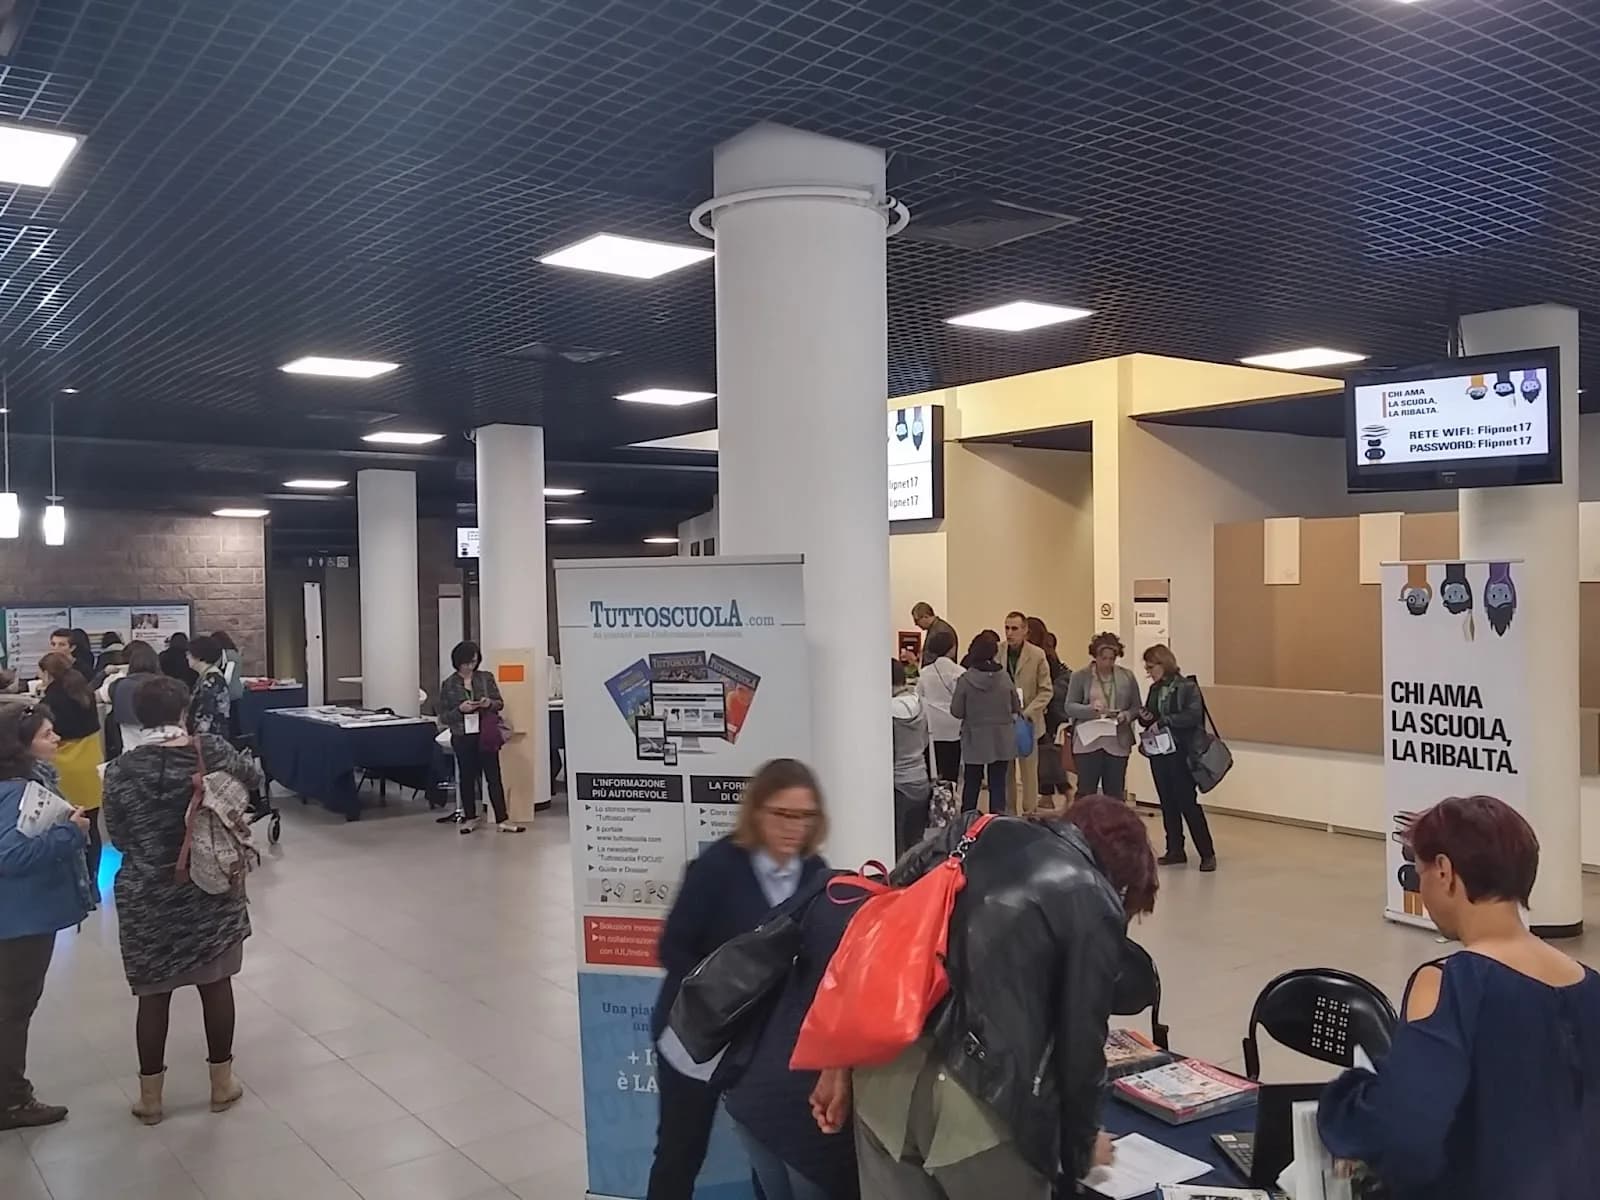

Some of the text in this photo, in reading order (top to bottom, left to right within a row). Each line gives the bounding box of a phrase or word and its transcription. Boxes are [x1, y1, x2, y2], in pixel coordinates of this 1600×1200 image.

[1388, 388, 1425, 398] CHI AMA
[1409, 422, 1532, 440] RETE WIFI: Flipnet17
[1409, 435, 1532, 453] PASSWORD: Flipnet17
[1391, 681, 1483, 709] CHI AMA
[1392, 710, 1512, 747] LA SCUOLA,
[1392, 738, 1518, 774] LA RIBALTA.
[592, 778, 667, 789] L'INFORMAZIONE
[708, 781, 721, 790] LA
[592, 787, 668, 799] PIÙ AUTOREVOLE
[720, 792, 731, 801] DI
[597, 845, 606, 853] La
[602, 1002, 627, 1014] Una
[617, 1069, 629, 1090] è
